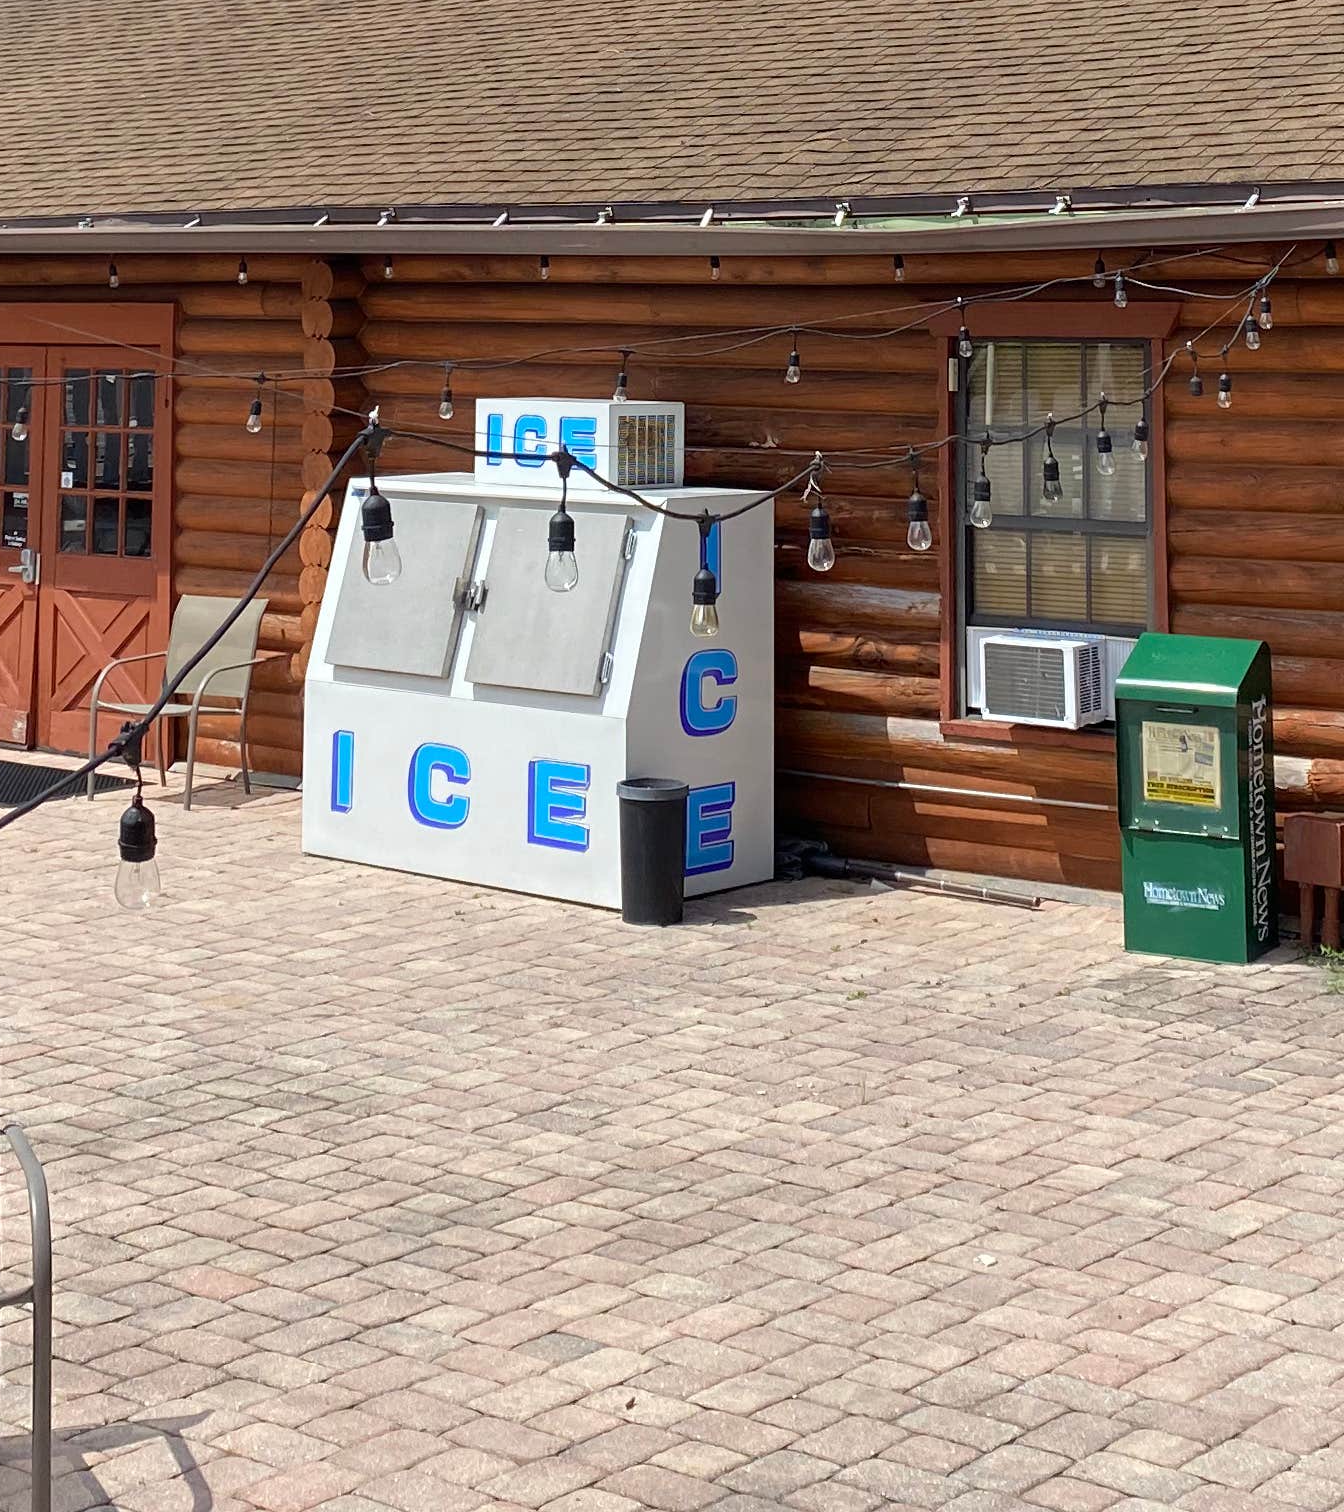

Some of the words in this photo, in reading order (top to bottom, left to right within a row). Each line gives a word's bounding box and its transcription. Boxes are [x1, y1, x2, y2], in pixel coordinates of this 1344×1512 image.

[487, 413, 597, 470] ICE
[679, 514, 738, 878] ICE
[331, 730, 591, 853] ICE
[1251, 694, 1267, 857] Hometown
[1143, 881, 1197, 904] Hometown
[1196, 887, 1226, 906] News
[1256, 856, 1272, 942] News
